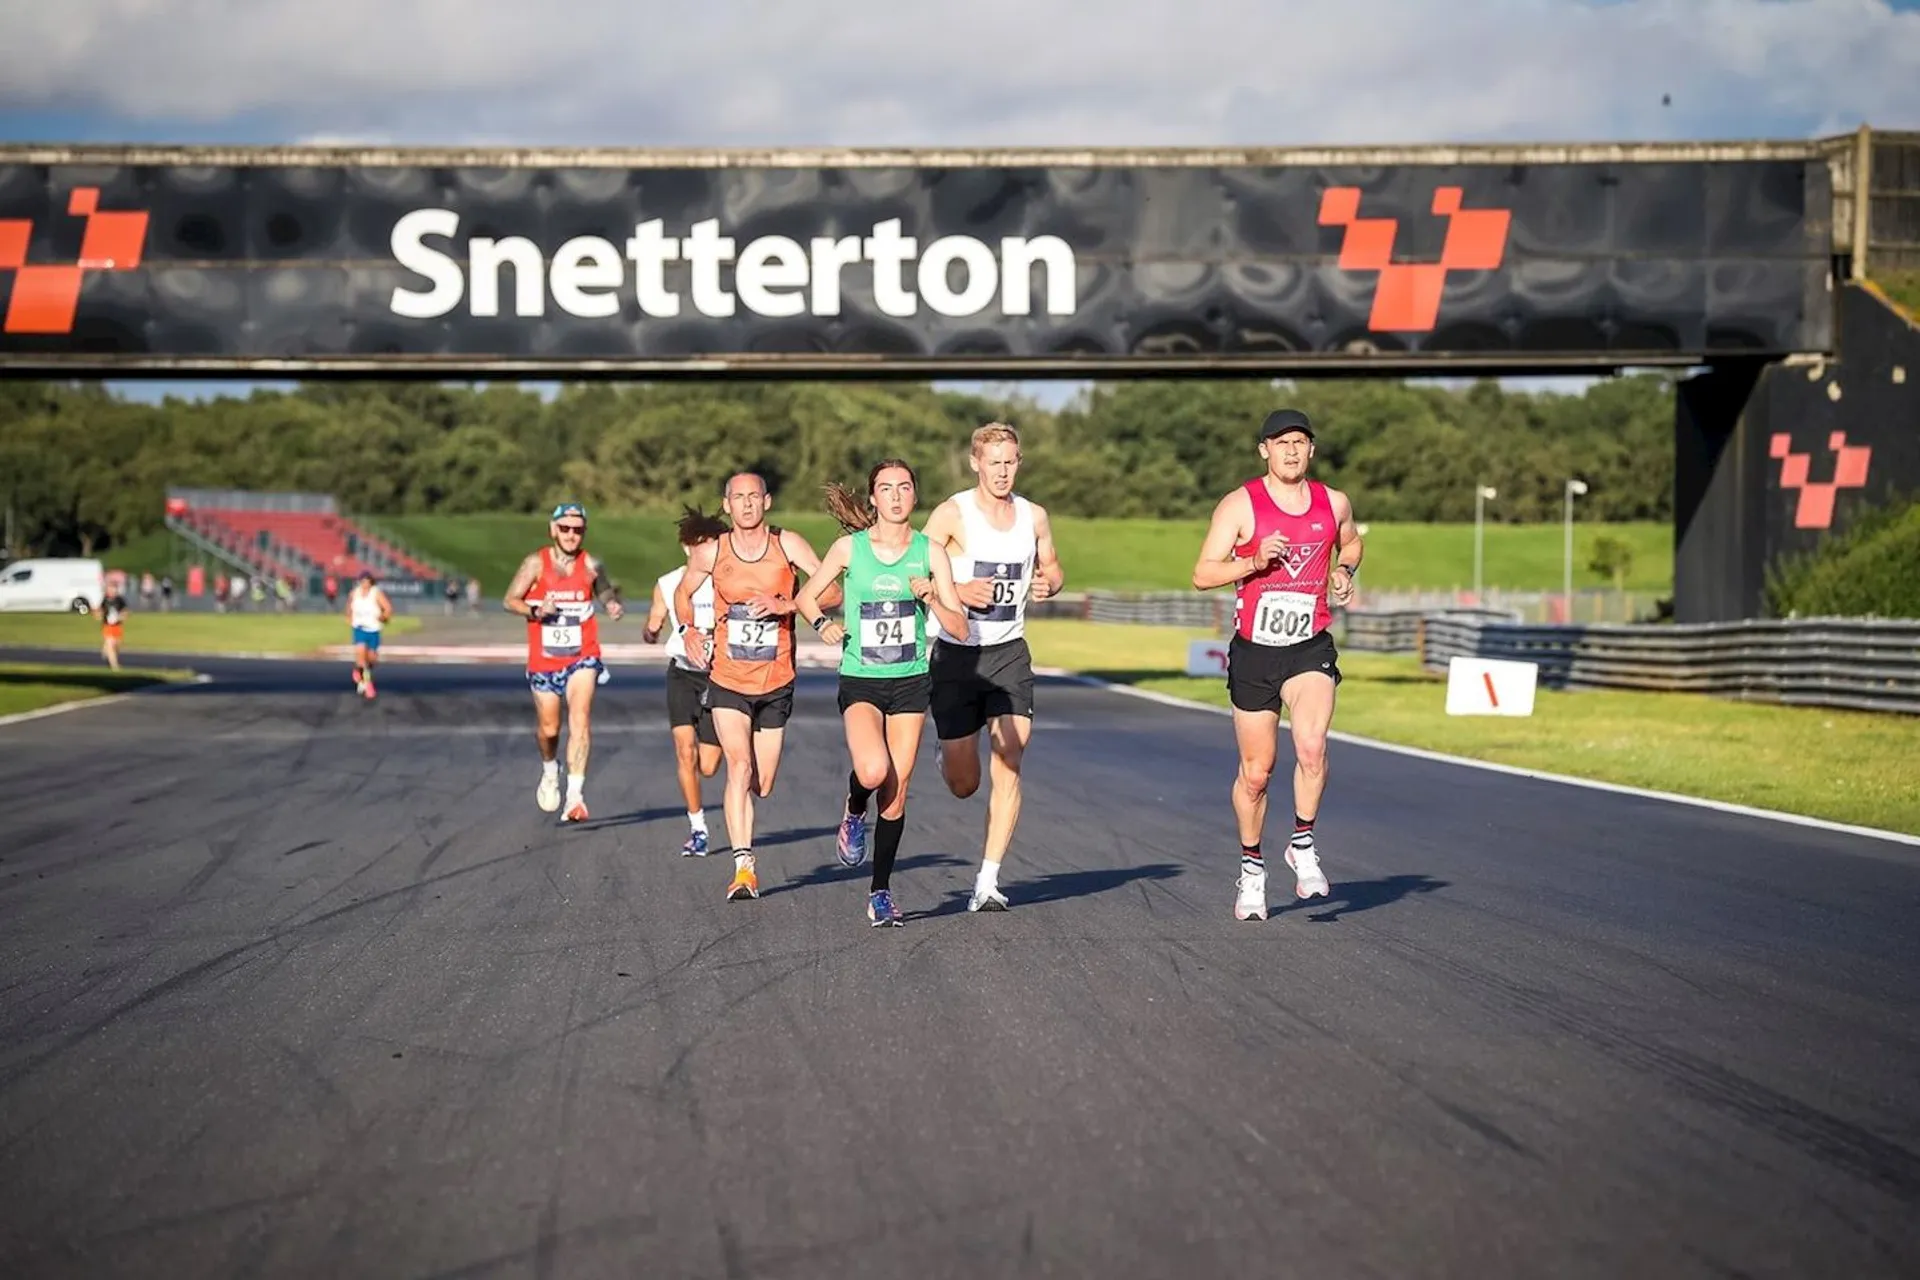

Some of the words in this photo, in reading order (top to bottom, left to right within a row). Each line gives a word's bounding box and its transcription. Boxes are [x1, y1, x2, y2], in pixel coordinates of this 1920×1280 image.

[390, 207, 1077, 318] Snetterton
[552, 629, 571, 645] 95
[875, 620, 903, 645] 94
[1259, 606, 1311, 637] 1802
[740, 623, 764, 654] 52
